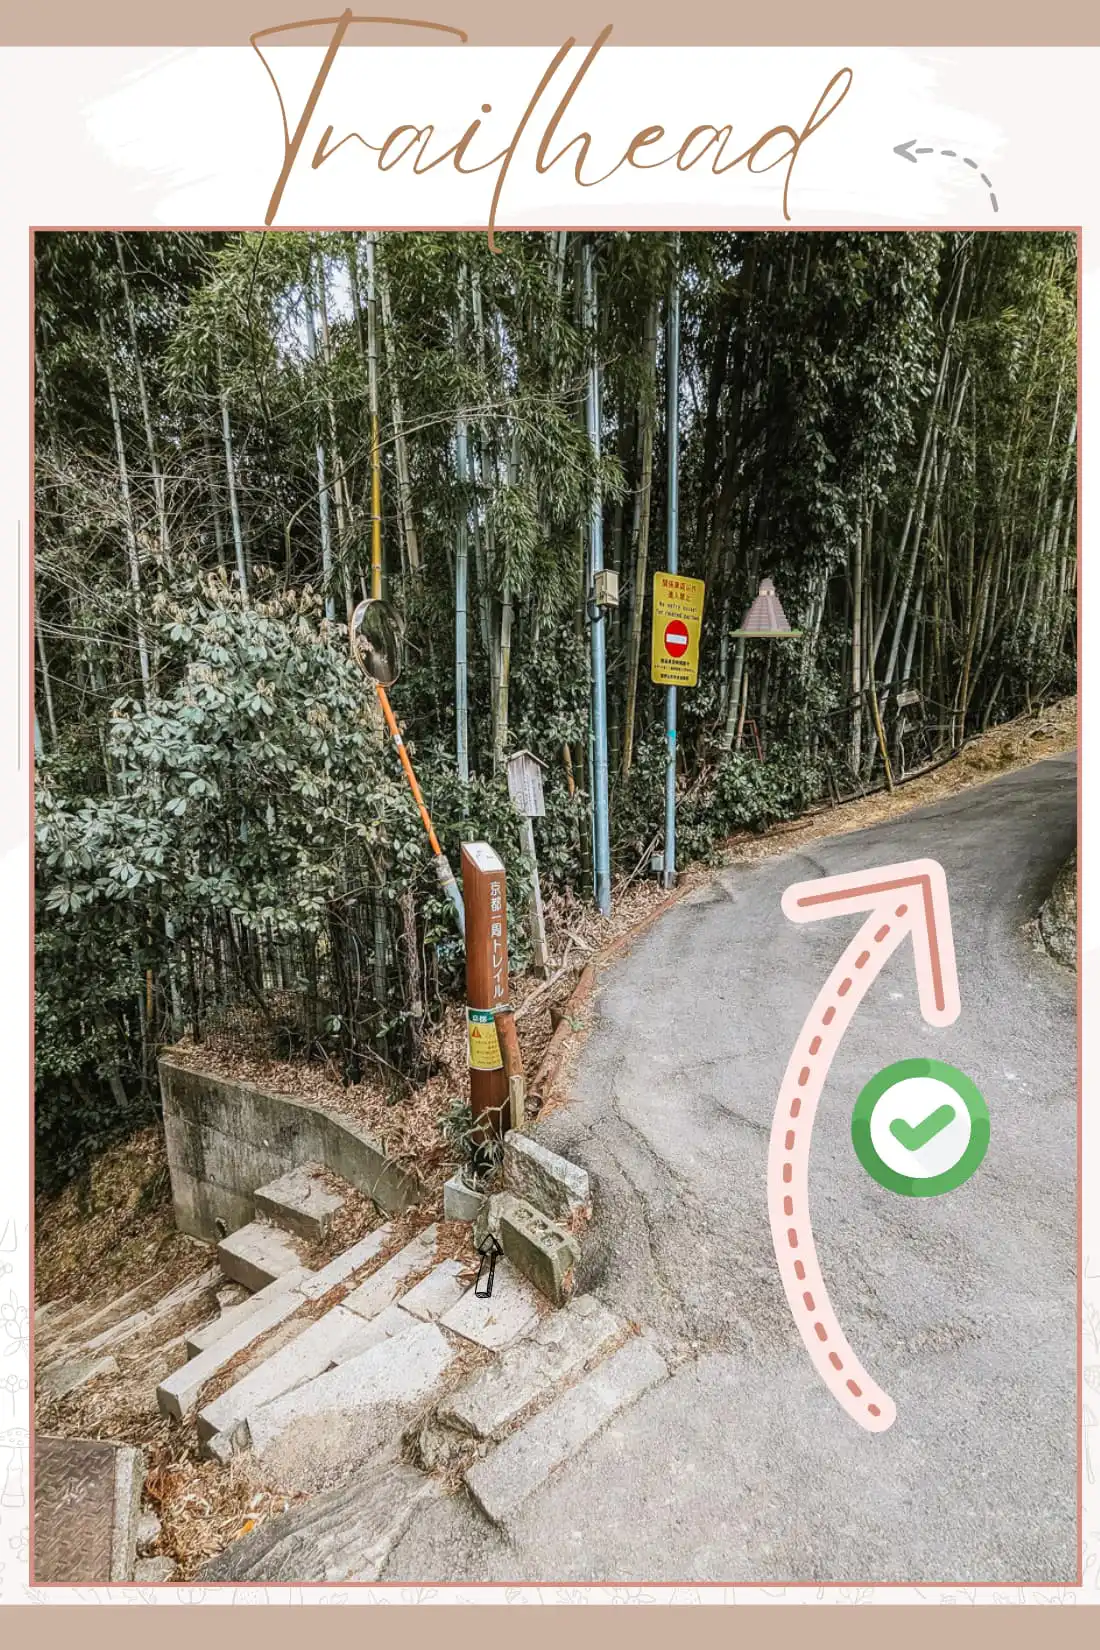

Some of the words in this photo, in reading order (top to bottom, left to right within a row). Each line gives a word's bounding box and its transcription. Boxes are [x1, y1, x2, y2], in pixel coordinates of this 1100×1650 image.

[489, 880, 505, 1000] 京都一周トレイル
